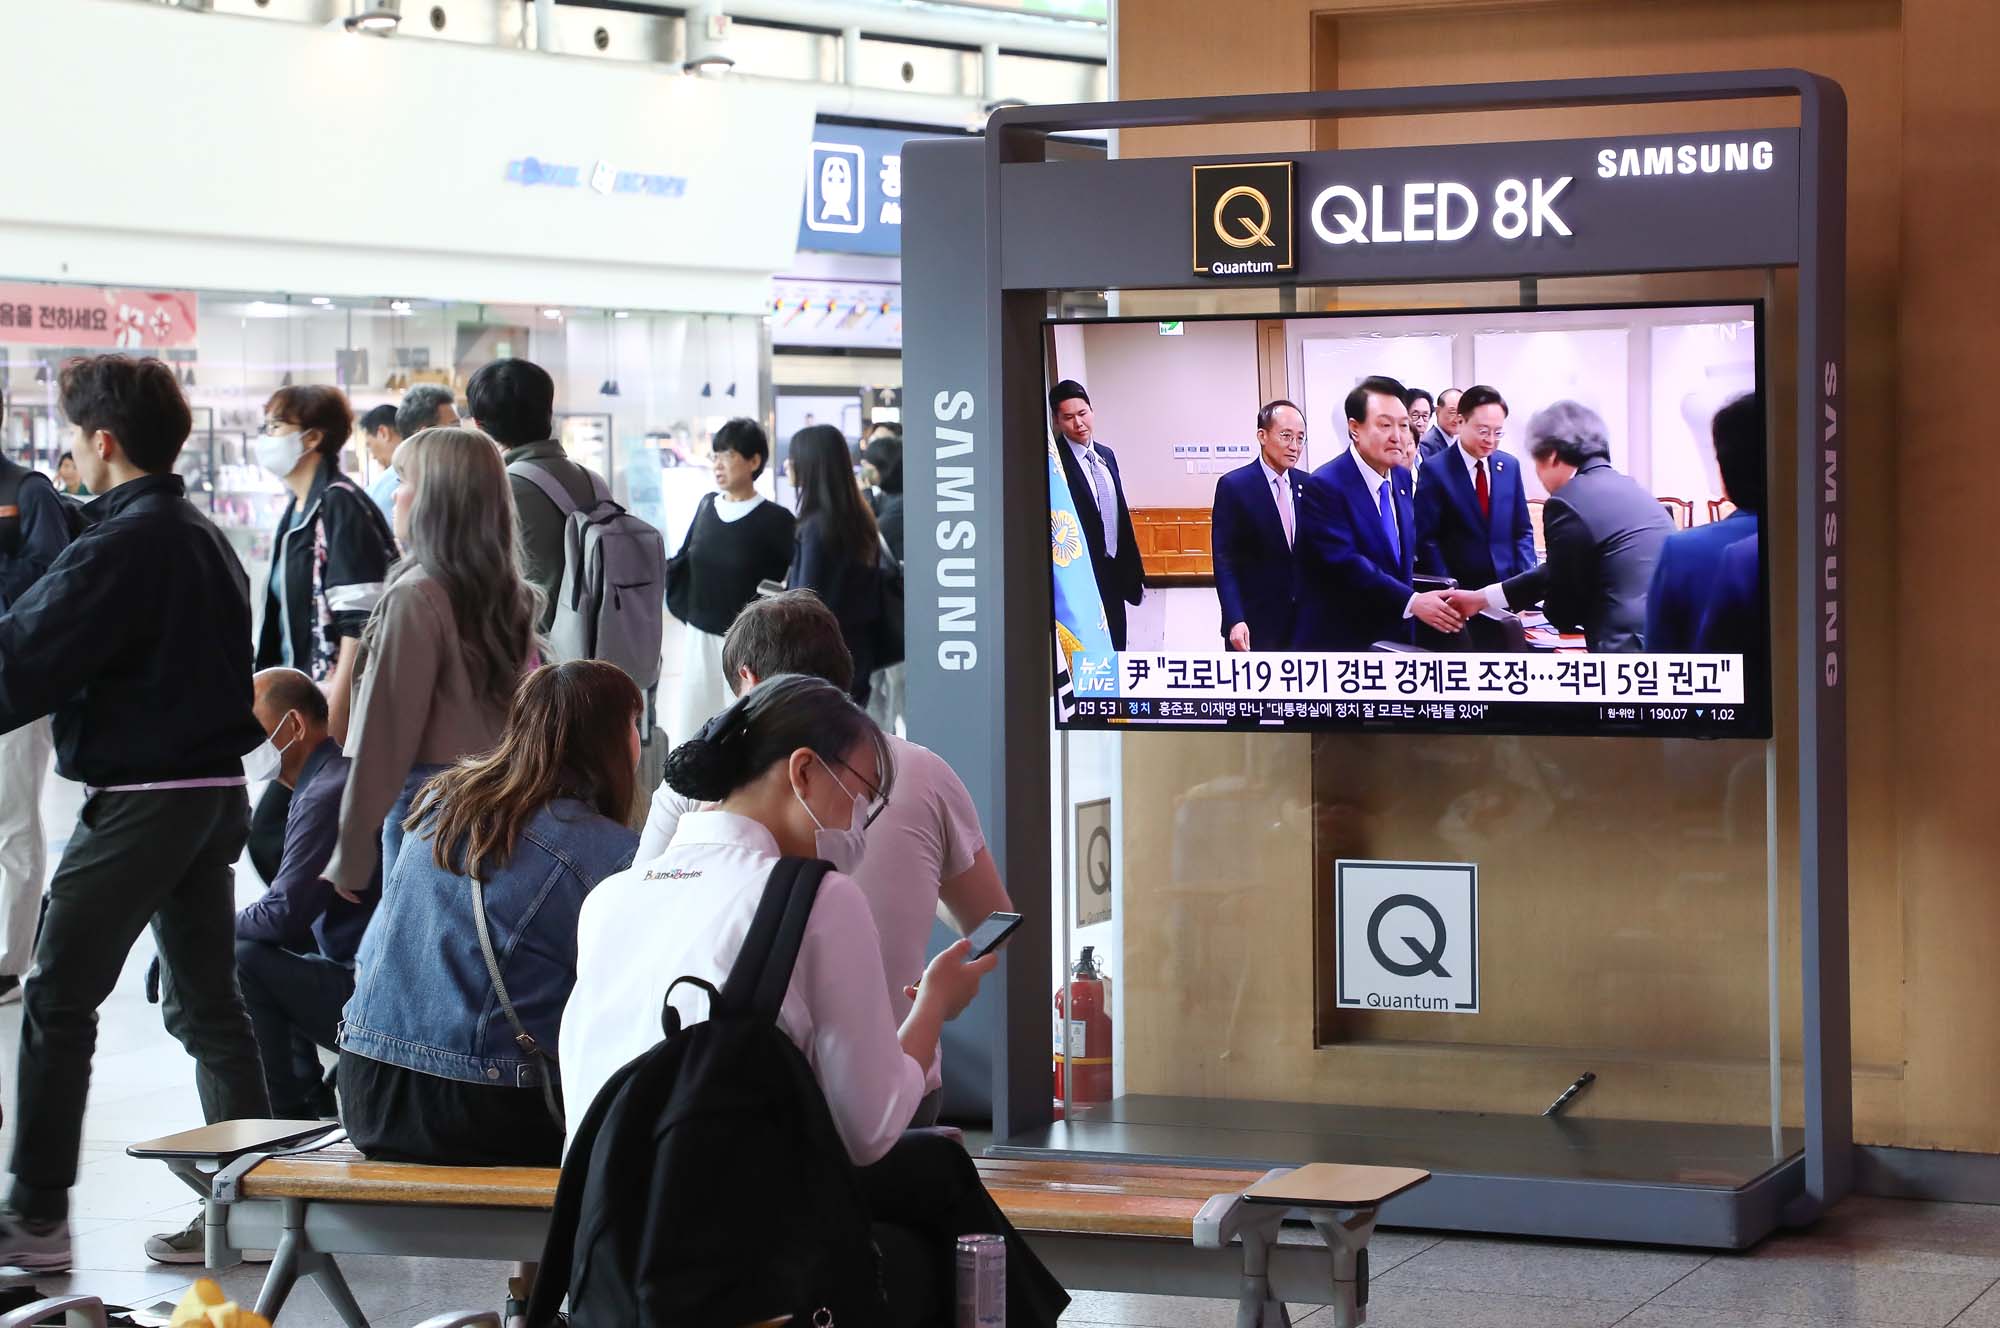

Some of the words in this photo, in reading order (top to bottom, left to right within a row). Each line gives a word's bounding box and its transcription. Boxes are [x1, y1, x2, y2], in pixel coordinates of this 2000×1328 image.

[1597, 140, 1773, 178] SAMSUNG
[1213, 185, 1276, 248] Q
[1311, 182, 1478, 244] QLED
[1492, 176, 1573, 240] 8K
[1212, 260, 1273, 274] Quantum
[39, 306, 108, 330] 전하세요
[934, 390, 977, 670] SAMSUNG
[1824, 360, 1838, 687] SAMSUNG
[1080, 656, 1112, 675] 뉴스
[1127, 659, 1150, 690] 尹
[1157, 656, 1272, 692] "코로나19
[1280, 658, 1328, 693] 위기
[1337, 659, 1387, 694] 경보
[1395, 659, 1470, 694] 경계로
[1617, 661, 1658, 696] 5일
[1668, 659, 1731, 696] 권고"
[1078, 677, 1115, 691] LIVE
[1128, 702, 1150, 716] 정치
[1159, 701, 1198, 717] 홍준표,
[1201, 702, 1236, 716] 이재명
[1239, 702, 1264, 717] 만나
[1266, 702, 1332, 717] "대통령실에
[1335, 703, 1359, 718] 정치
[1362, 703, 1375, 718] 잘
[1378, 704, 1415, 718] 모르는
[1418, 704, 1456, 719] 사람들
[1458, 704, 1489, 719] 있어"
[1607, 707, 1635, 719] 원-위안
[1650, 708, 1687, 720] 190.07
[1711, 708, 1735, 720] 1.02
[1367, 893, 1453, 978] Q
[1367, 993, 1449, 1010] Quantum
